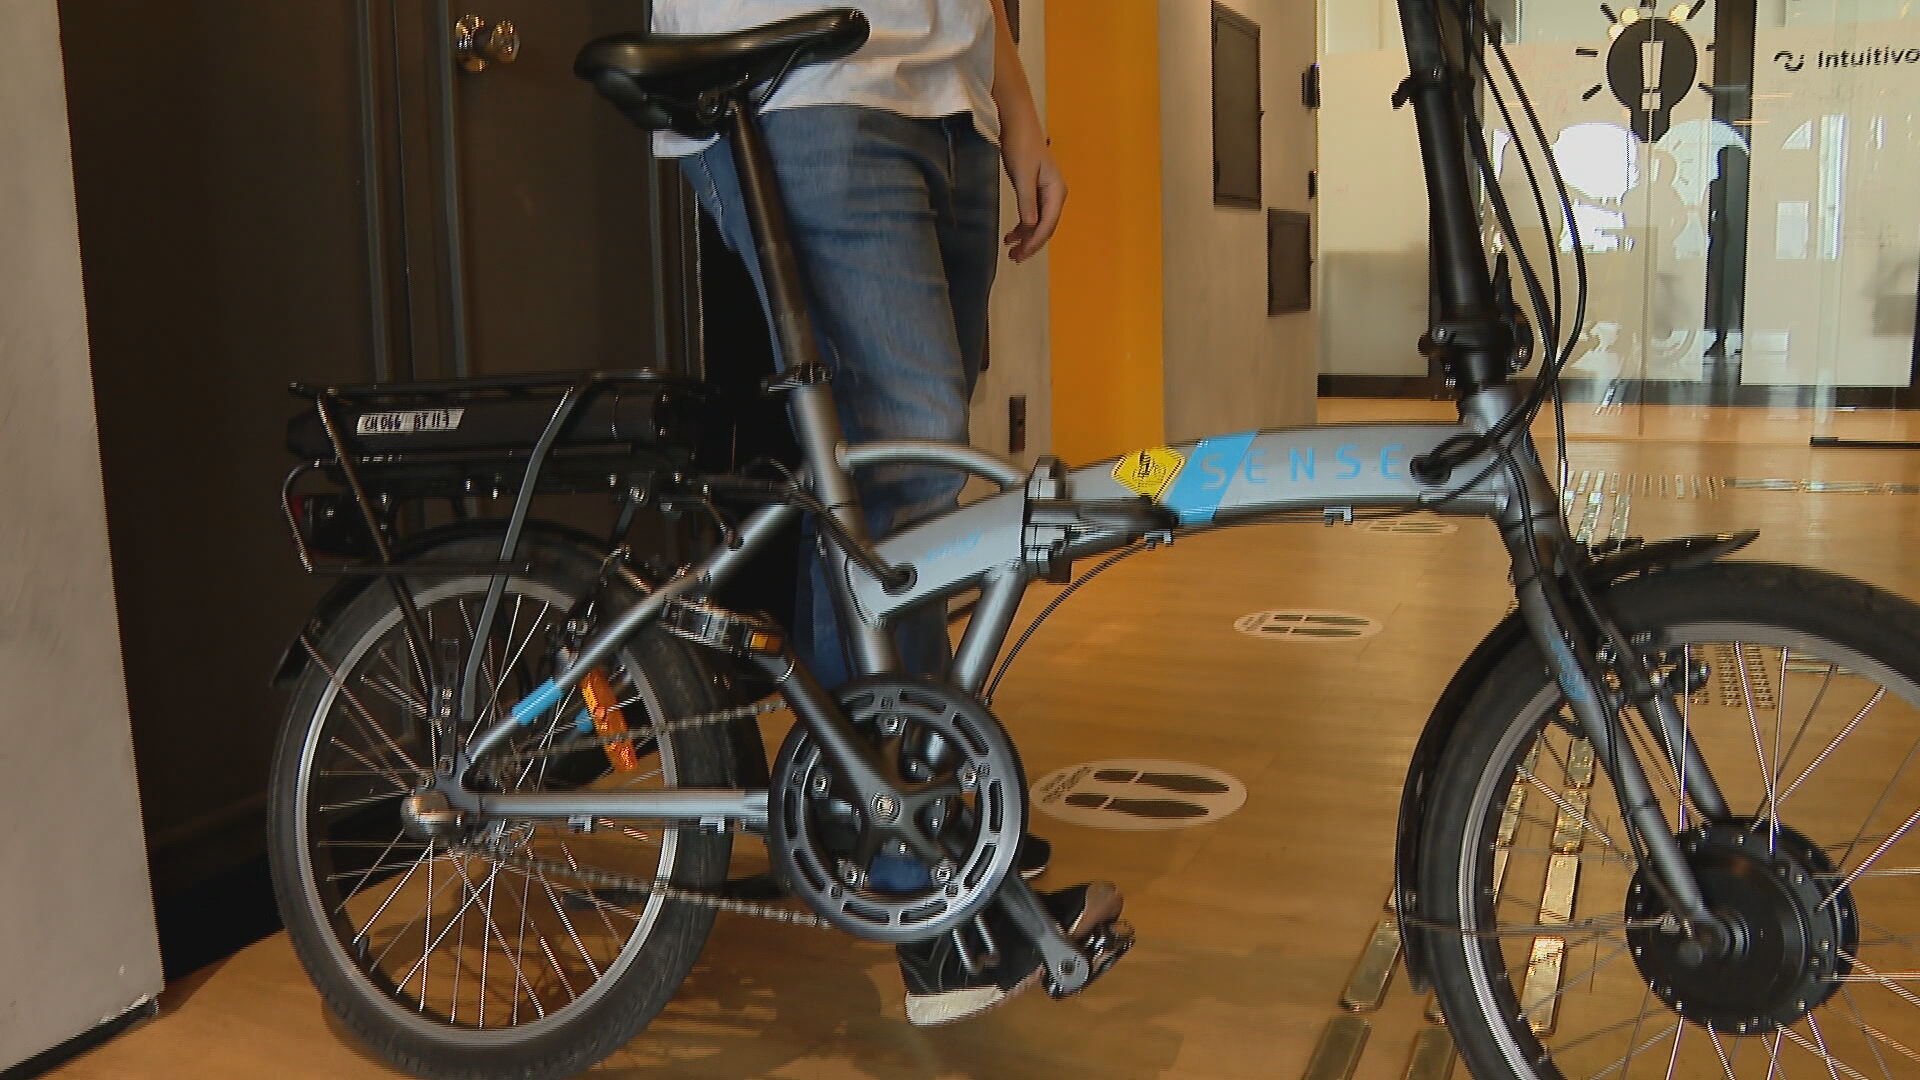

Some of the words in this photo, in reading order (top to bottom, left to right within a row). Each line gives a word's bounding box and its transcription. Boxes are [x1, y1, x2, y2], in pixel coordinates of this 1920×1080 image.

[1818, 46, 1920, 69] Intuitivo
[414, 413, 429, 431] BT
[1201, 443, 1404, 489] SENSE
